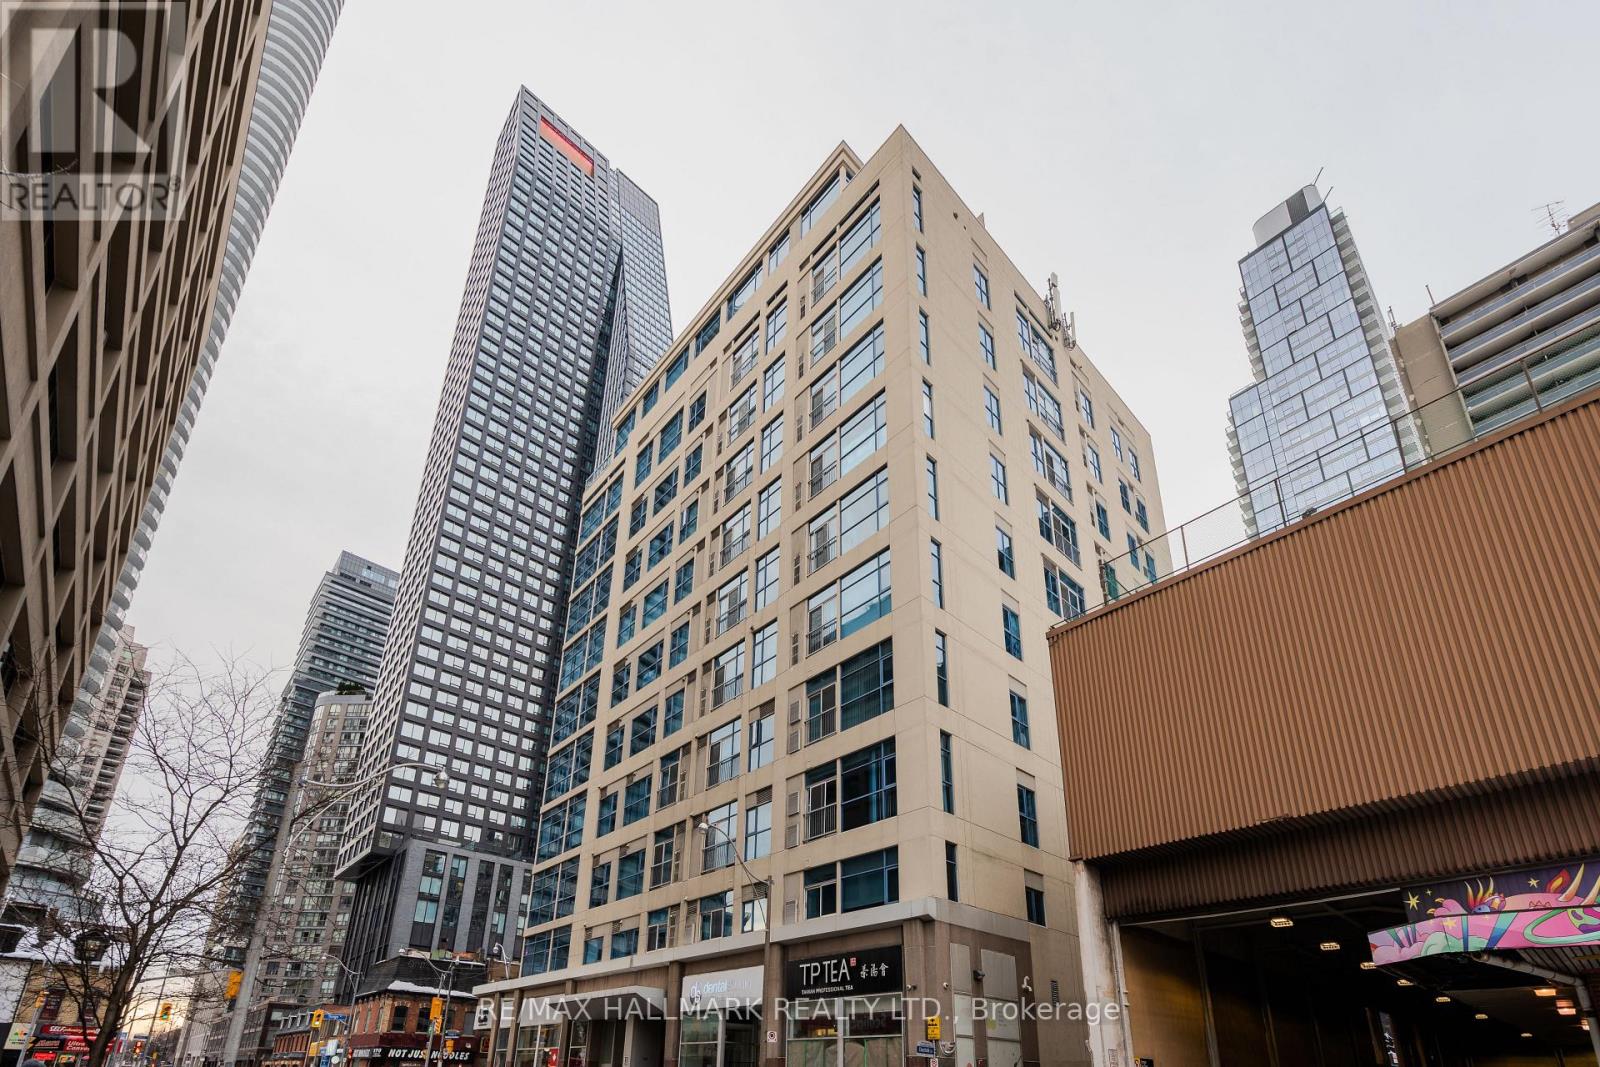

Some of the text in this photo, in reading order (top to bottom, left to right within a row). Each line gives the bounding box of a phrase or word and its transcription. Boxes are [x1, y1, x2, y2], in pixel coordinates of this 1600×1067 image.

[703, 981, 727, 993] dental
[388, 1048, 407, 1058] NOT
[408, 1048, 427, 1059] JUS
